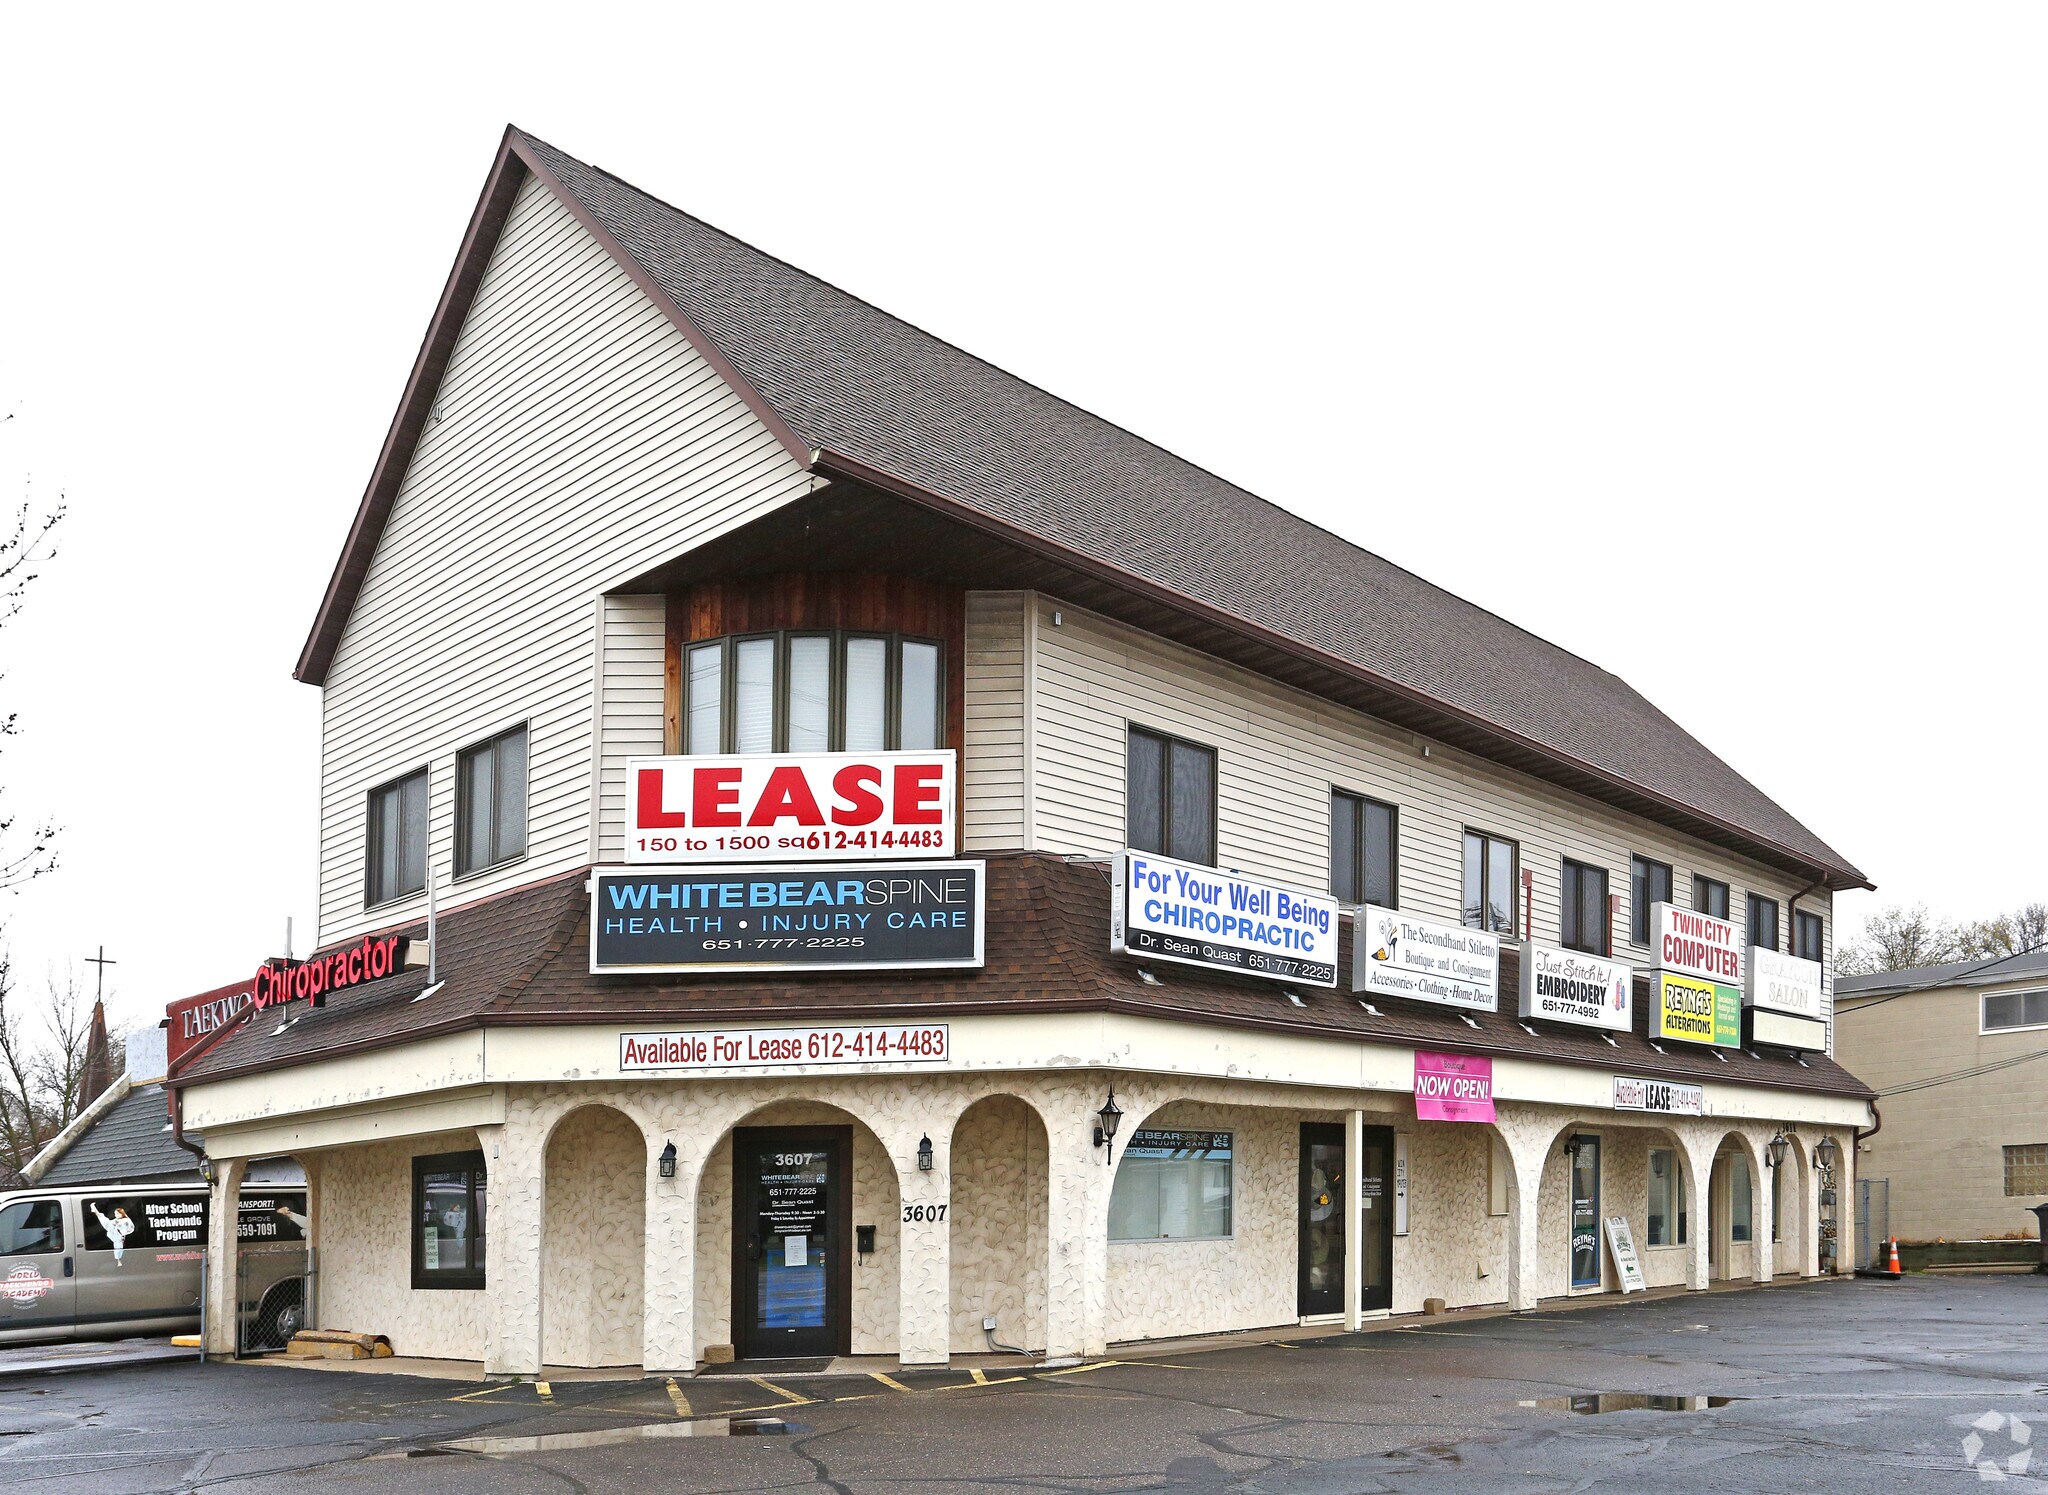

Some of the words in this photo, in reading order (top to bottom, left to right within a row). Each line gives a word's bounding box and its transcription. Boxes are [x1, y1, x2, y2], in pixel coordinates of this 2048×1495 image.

[637, 764, 943, 829] LEASE
[637, 838, 677, 851] 150
[684, 838, 708, 851] to
[715, 836, 770, 850] 1500
[1134, 860, 1171, 894] For
[1175, 869, 1222, 905] Your
[1229, 883, 1270, 916] Well
[1277, 893, 1330, 934] Being
[606, 916, 722, 934] HEALTH
[762, 913, 871, 931] INJURY
[887, 911, 967, 929] CARE
[1144, 899, 1315, 951] CHIROPRACTIC
[1672, 911, 1703, 939] TWIN
[1705, 920, 1731, 945] CITY
[1139, 933, 1159, 948] Dr.
[1164, 938, 1199, 954] Sean
[1203, 945, 1241, 962] Quast
[1401, 923, 1417, 941] The
[1419, 926, 1466, 952] Secondhand
[1468, 939, 1496, 958] Stiletto
[1405, 949, 1434, 970] Boutique
[1438, 958, 1449, 970] and
[1452, 959, 1492, 979] Consignment
[1536, 950, 1563, 974] Just
[1563, 959, 1596, 980] Stitch
[1663, 934, 1738, 978] COMPUTER
[253, 935, 398, 1009] Chiropractor
[1370, 971, 1414, 990] Accessories
[1418, 978, 1449, 999] Clothing
[1452, 985, 1472, 1001] Home
[1474, 988, 1494, 1004] Decor
[1537, 973, 1607, 1006] EMBROIDERY
[1665, 983, 1712, 1017] REYNA'S
[1769, 982, 1809, 1009] SALON
[181, 989, 255, 1039] TAEKWO
[1542, 999, 1600, 1018] 651-777-4992
[1666, 1014, 1711, 1034] ALTERATIONS
[624, 1036, 707, 1064] Available
[714, 1036, 742, 1061] For
[748, 1035, 802, 1060] Lease
[807, 1029, 944, 1058] 612-414-4483
[1444, 1060, 1466, 1070] Boutique
[1416, 1075, 1451, 1097] NOW
[1453, 1078, 1489, 1099] OPEN!
[1645, 1085, 1670, 1110] LEASE
[775, 1153, 813, 1166] 3607
[146, 1204, 169, 1215] After
[170, 1203, 203, 1214] School
[148, 1215, 202, 1228] Taekwondo
[902, 1204, 947, 1222] 3607
[156, 1230, 197, 1241] Program
[237, 1223, 277, 1236] 559-7091
[1573, 1234, 1595, 1248] REYNA'S
[3, 1289, 48, 1298] ACADEMY
